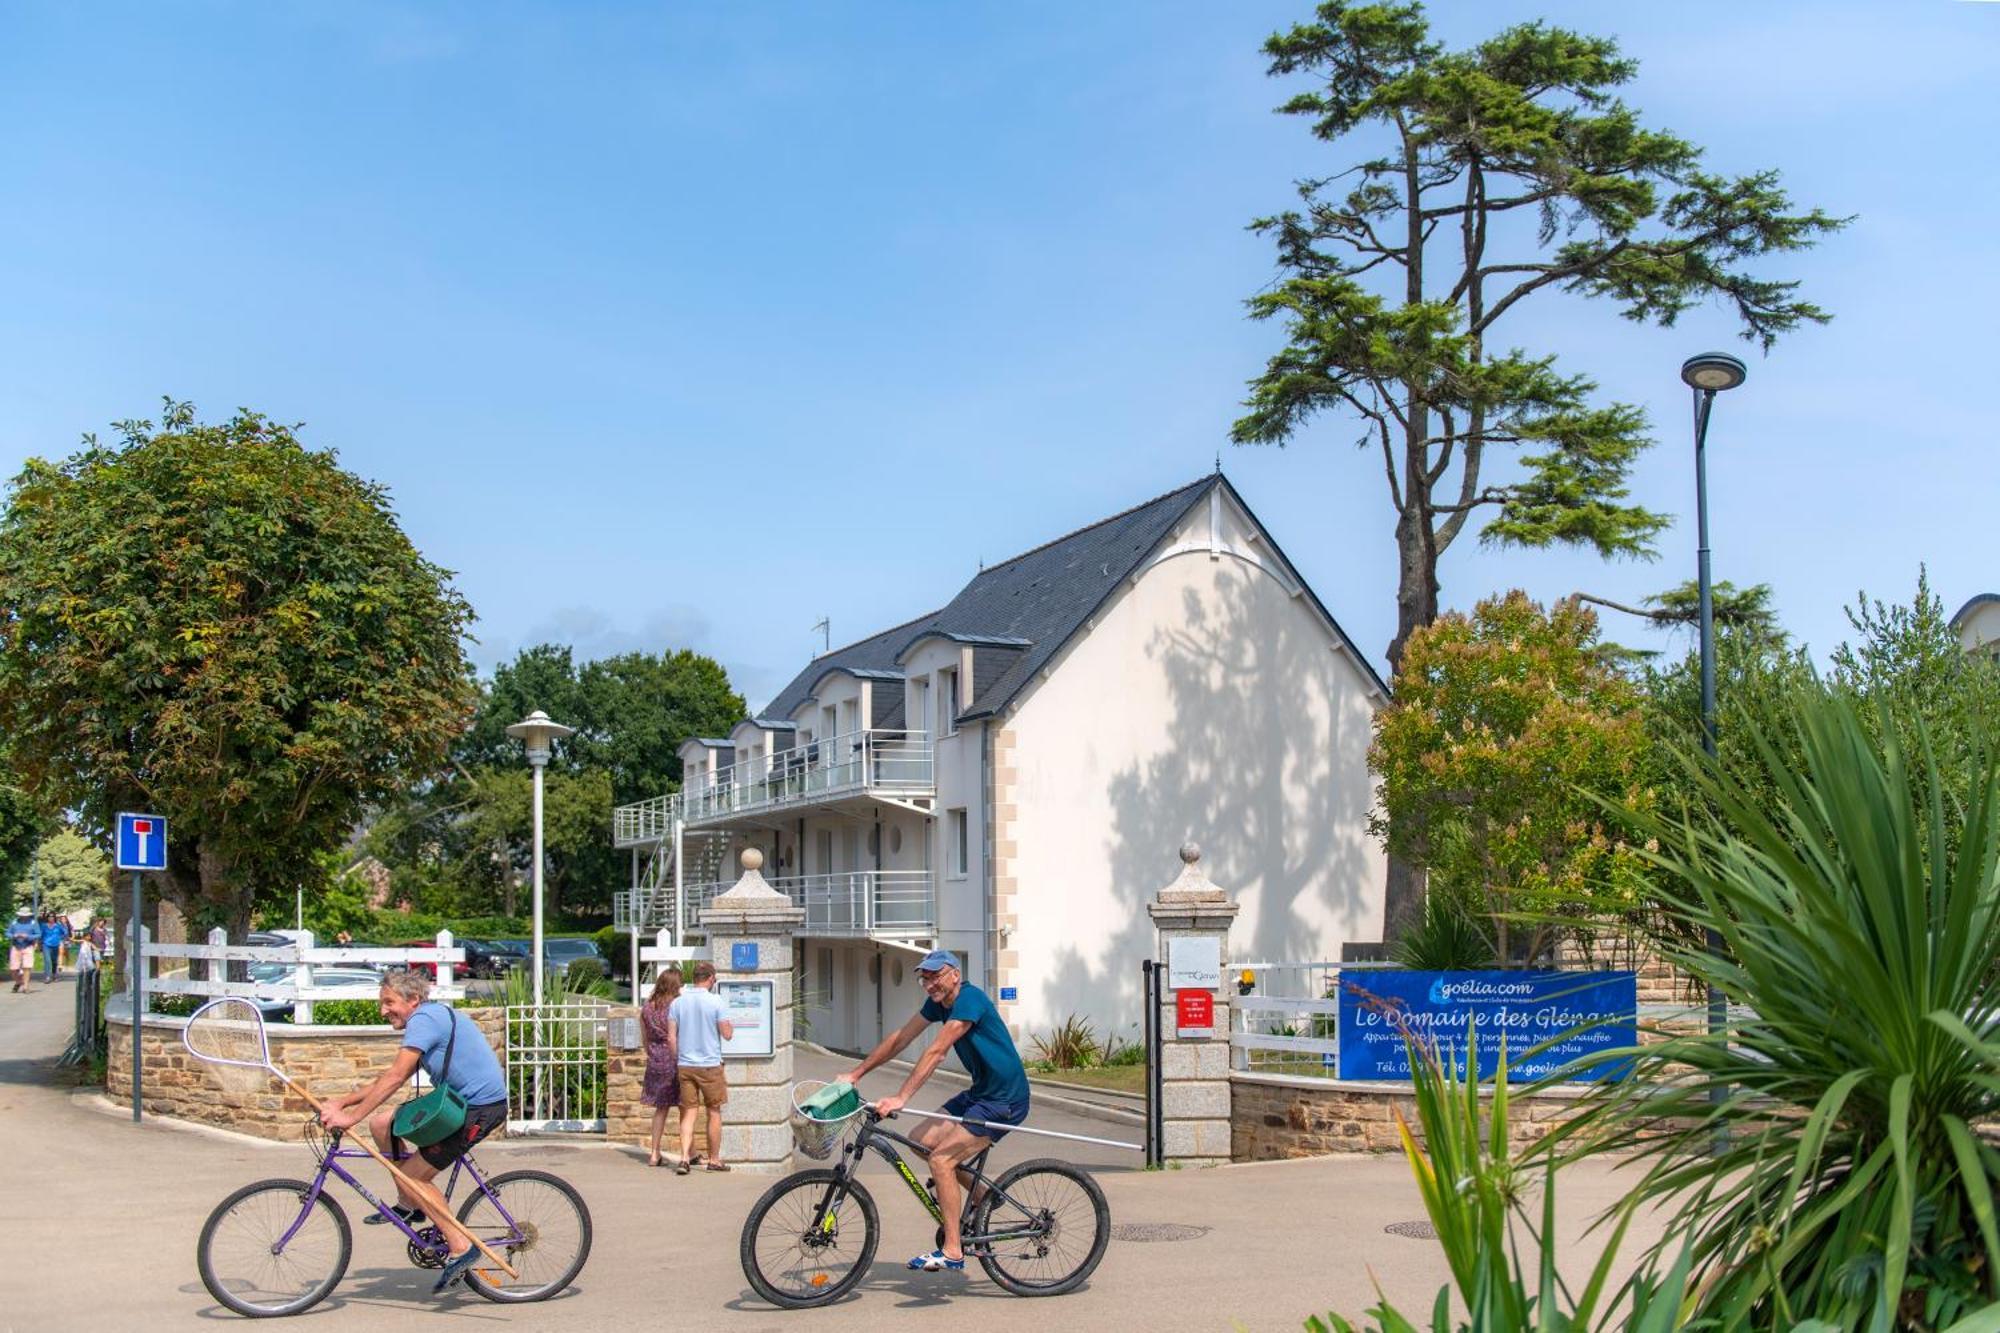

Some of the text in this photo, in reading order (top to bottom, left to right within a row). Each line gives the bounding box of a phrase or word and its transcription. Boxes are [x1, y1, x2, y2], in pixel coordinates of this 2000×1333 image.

[1442, 979, 1533, 999] goélia.com
[1356, 1008, 1382, 1026] Le
[1384, 1008, 1490, 1027] Domaine
[1494, 1006, 1533, 1026] des
[1482, 1033, 1530, 1044] persnnes,
